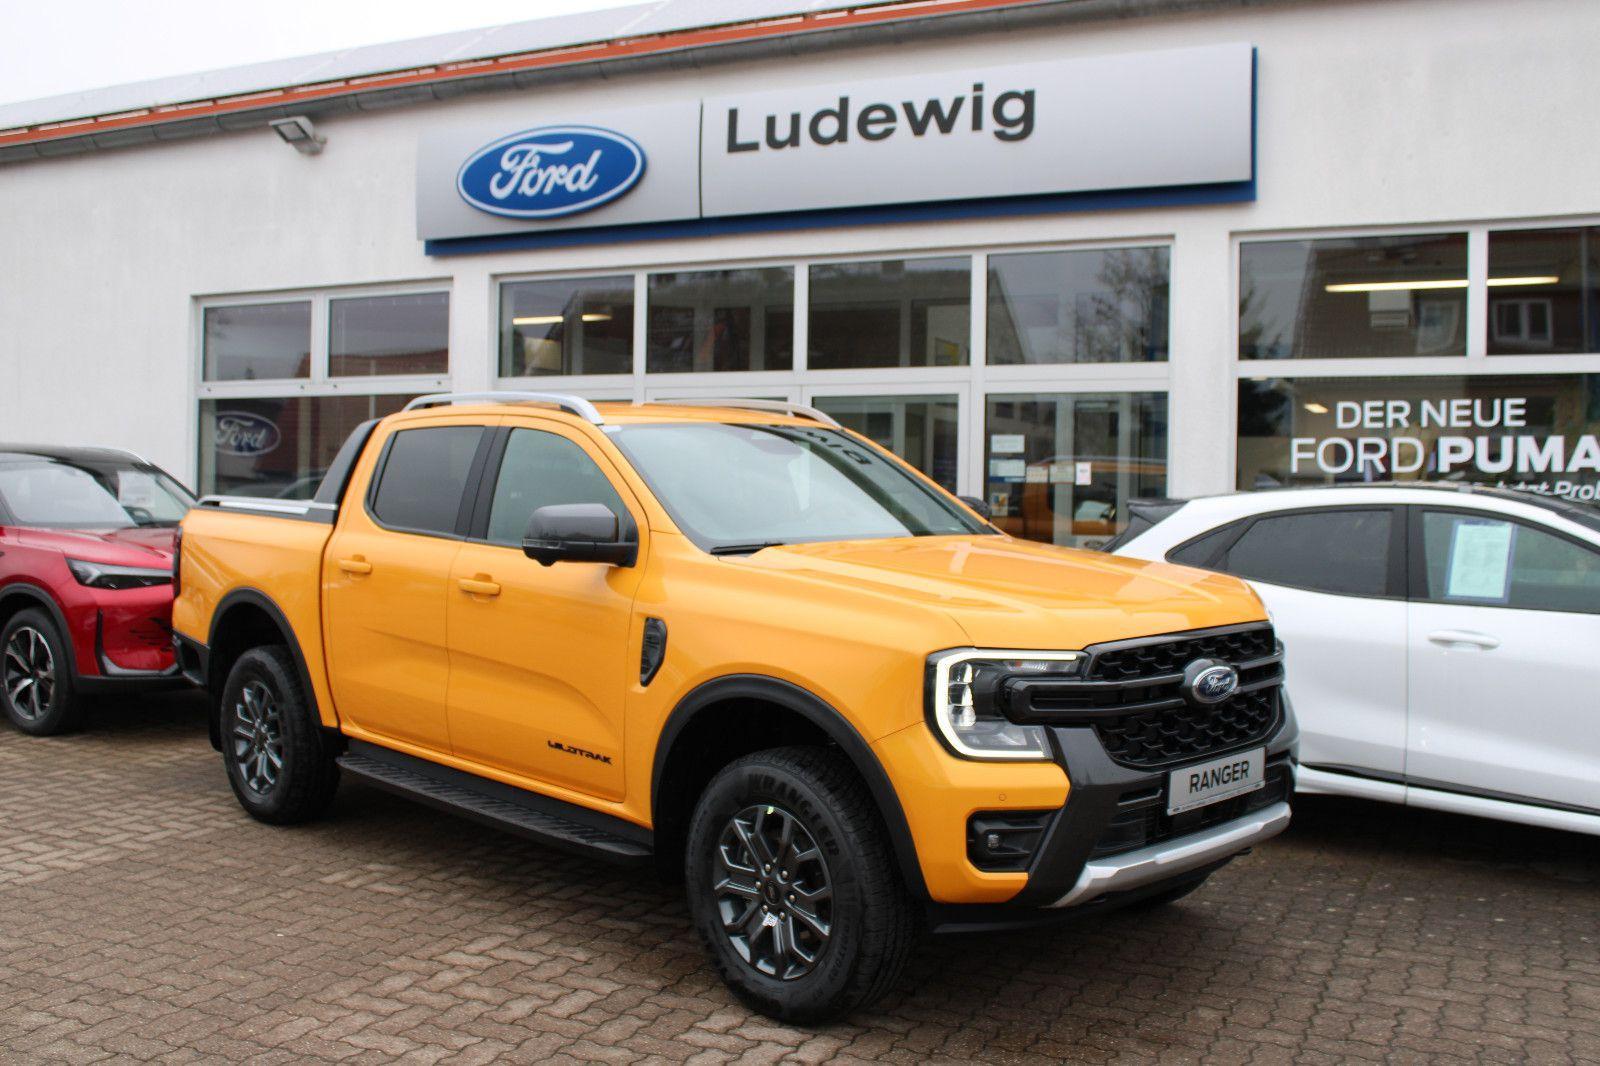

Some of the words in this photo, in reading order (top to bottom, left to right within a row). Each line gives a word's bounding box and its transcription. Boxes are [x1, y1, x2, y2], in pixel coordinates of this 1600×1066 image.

[727, 83, 1036, 153] Ludewig
[489, 140, 602, 199] Ford
[1336, 400, 1410, 429] DER
[1421, 398, 1527, 427] NEUE
[215, 416, 267, 448] Ford
[1289, 436, 1425, 475] FORD
[1437, 435, 1600, 474] PUMA
[1189, 760, 1249, 793] RANGER
